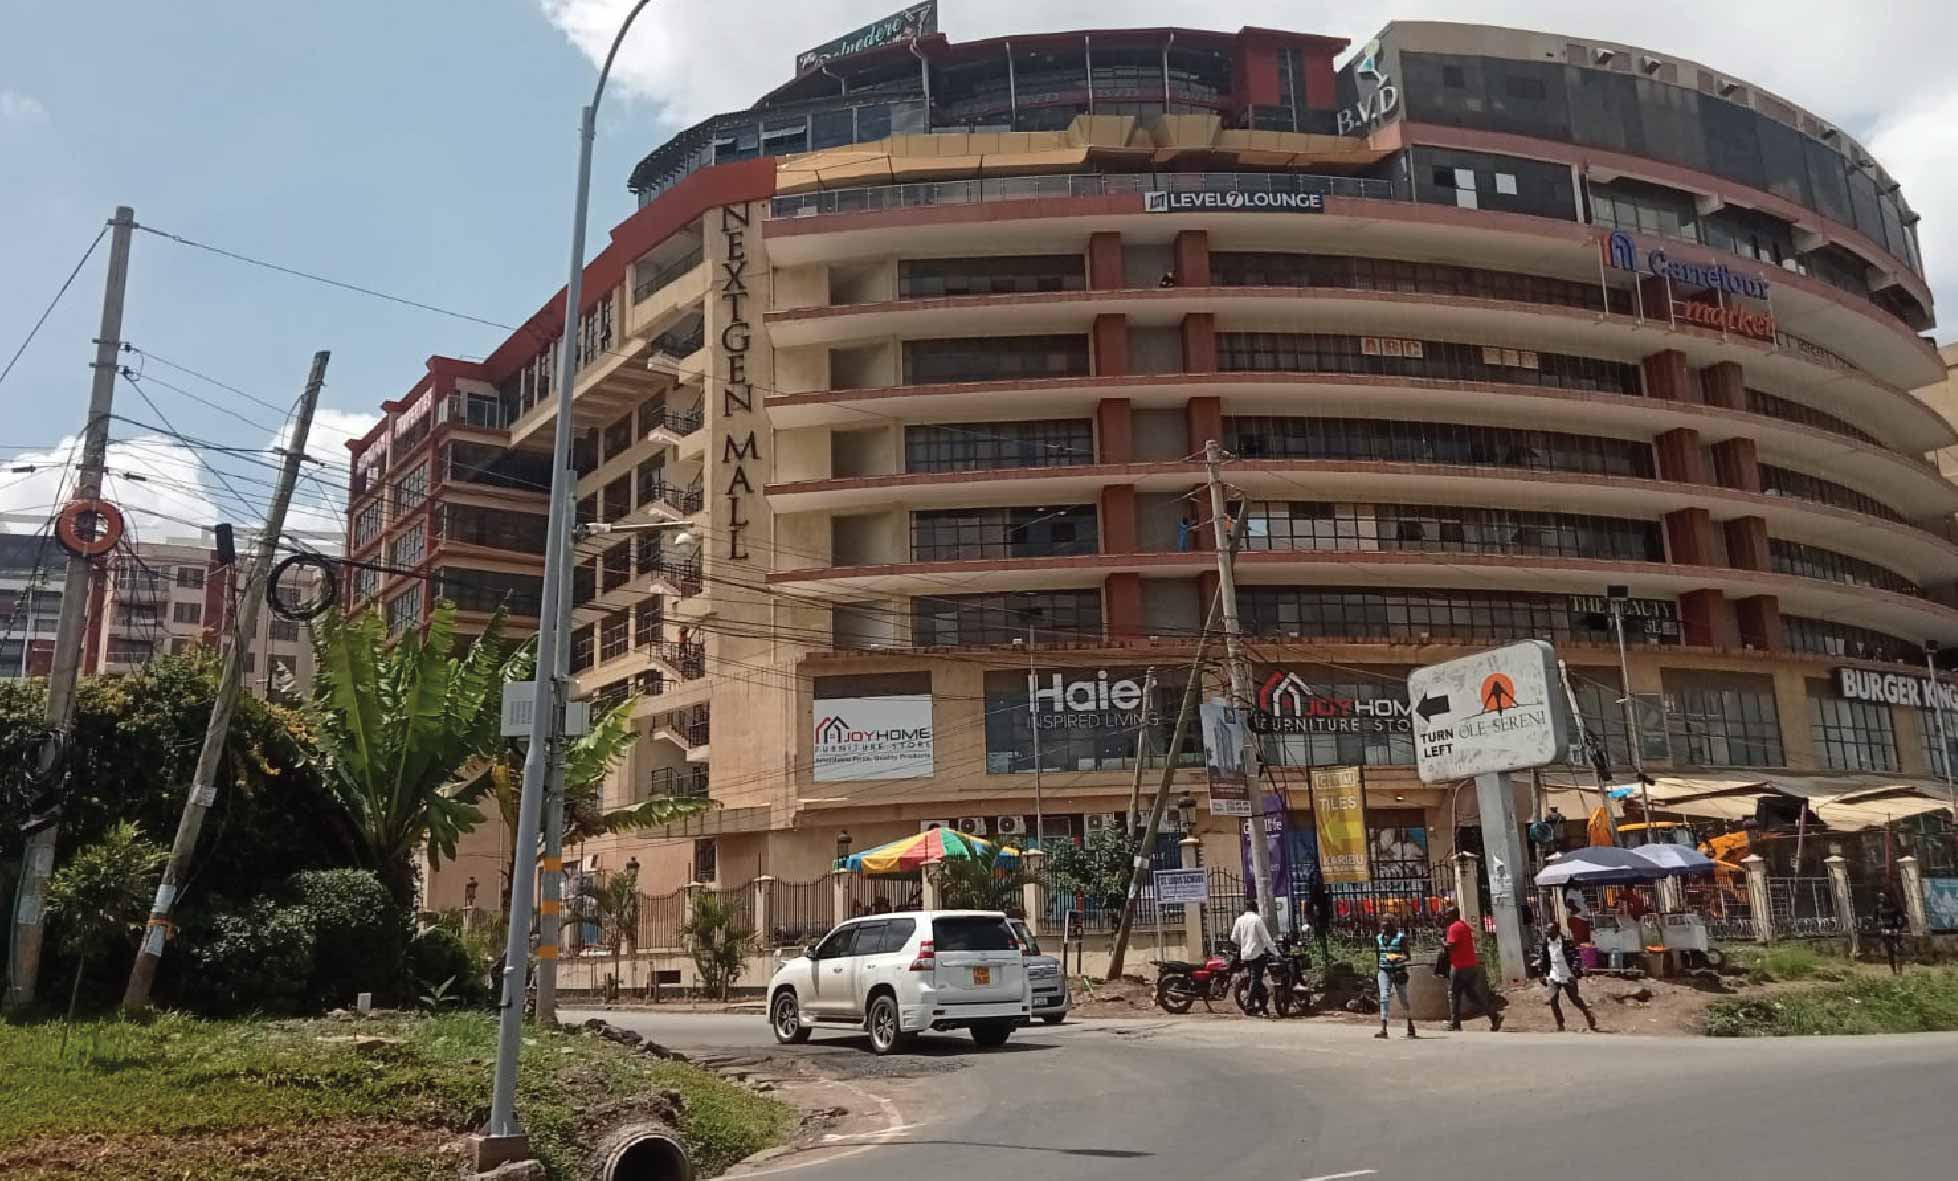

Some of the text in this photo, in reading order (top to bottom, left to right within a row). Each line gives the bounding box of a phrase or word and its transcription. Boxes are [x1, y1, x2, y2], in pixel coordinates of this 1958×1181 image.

[721, 202, 762, 560] NEXTGEN MALL
[1841, 668, 1921, 705] BURGER
[1305, 699, 1412, 716] JOYHOM
[1374, 717, 1411, 731] STO
[1458, 710, 1546, 739] OLE SERENI
[1420, 728, 1454, 744] TURN
[1424, 744, 1453, 758] LEFT
[1320, 796, 1358, 811] TILES
